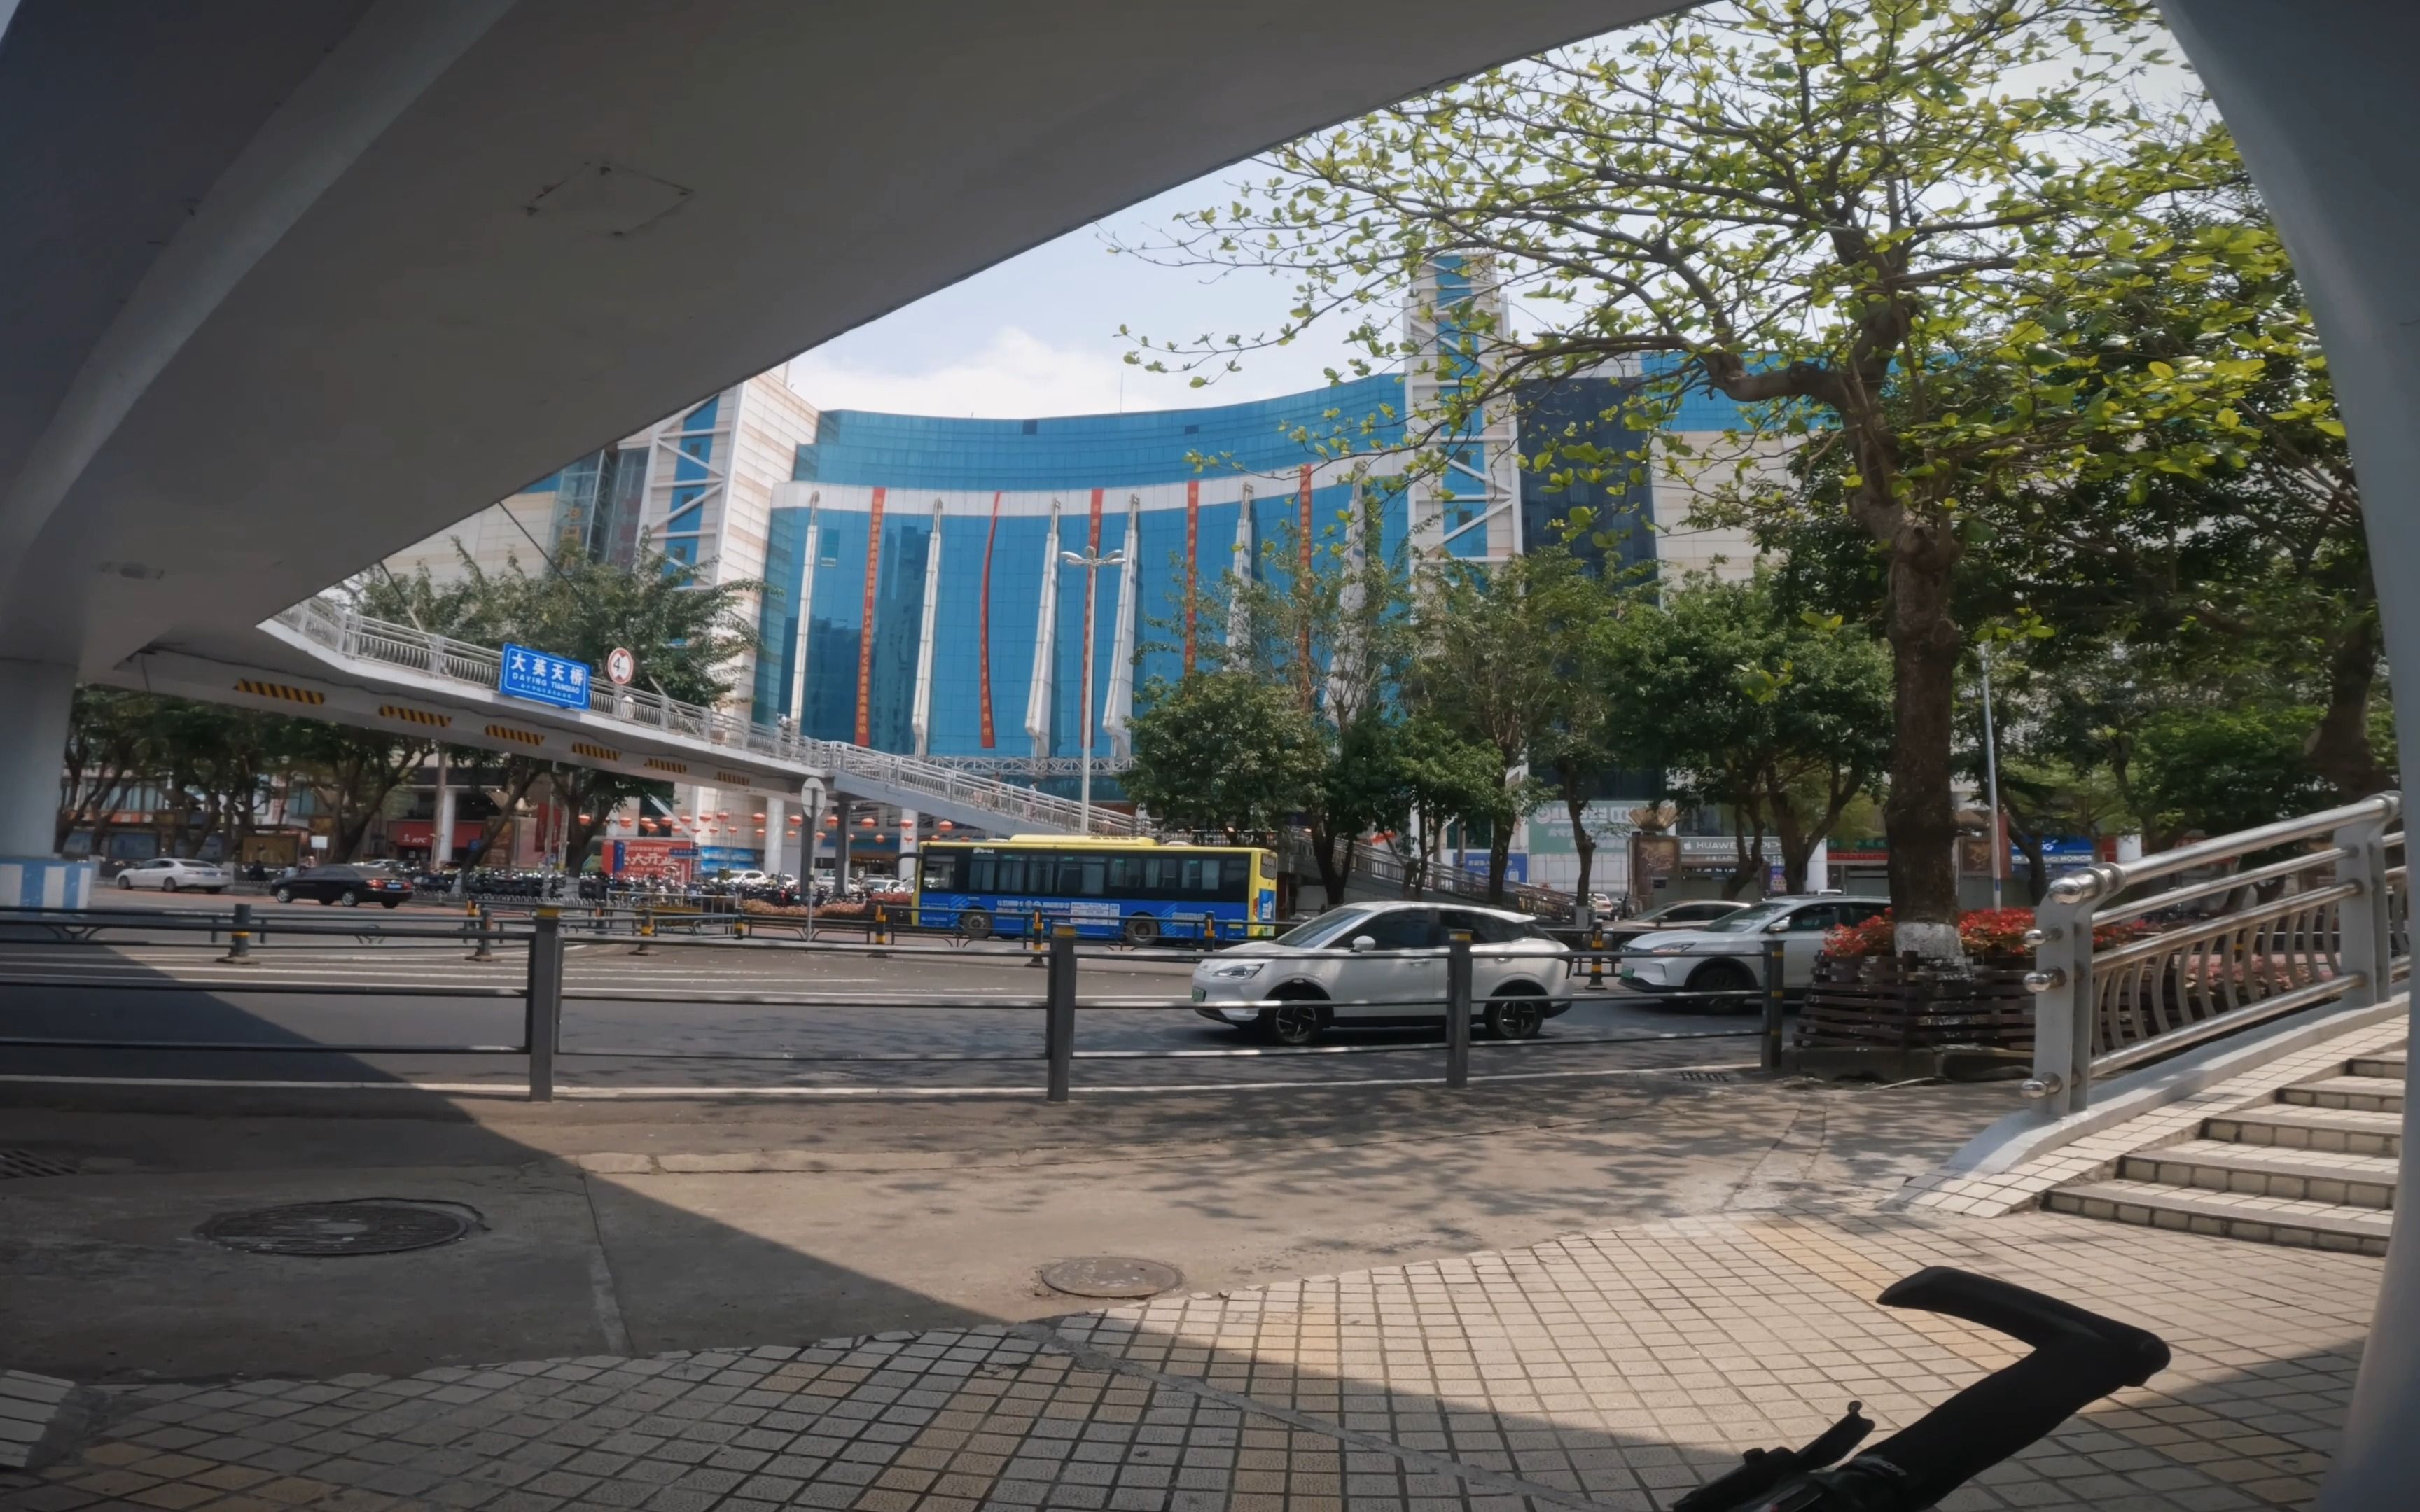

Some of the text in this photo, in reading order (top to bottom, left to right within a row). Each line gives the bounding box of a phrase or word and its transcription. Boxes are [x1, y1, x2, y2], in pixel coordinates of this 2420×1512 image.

[511, 653, 583, 686] 大英天桥
[512, 673, 547, 687] DAYING
[1697, 841, 1738, 850] HUAWE
